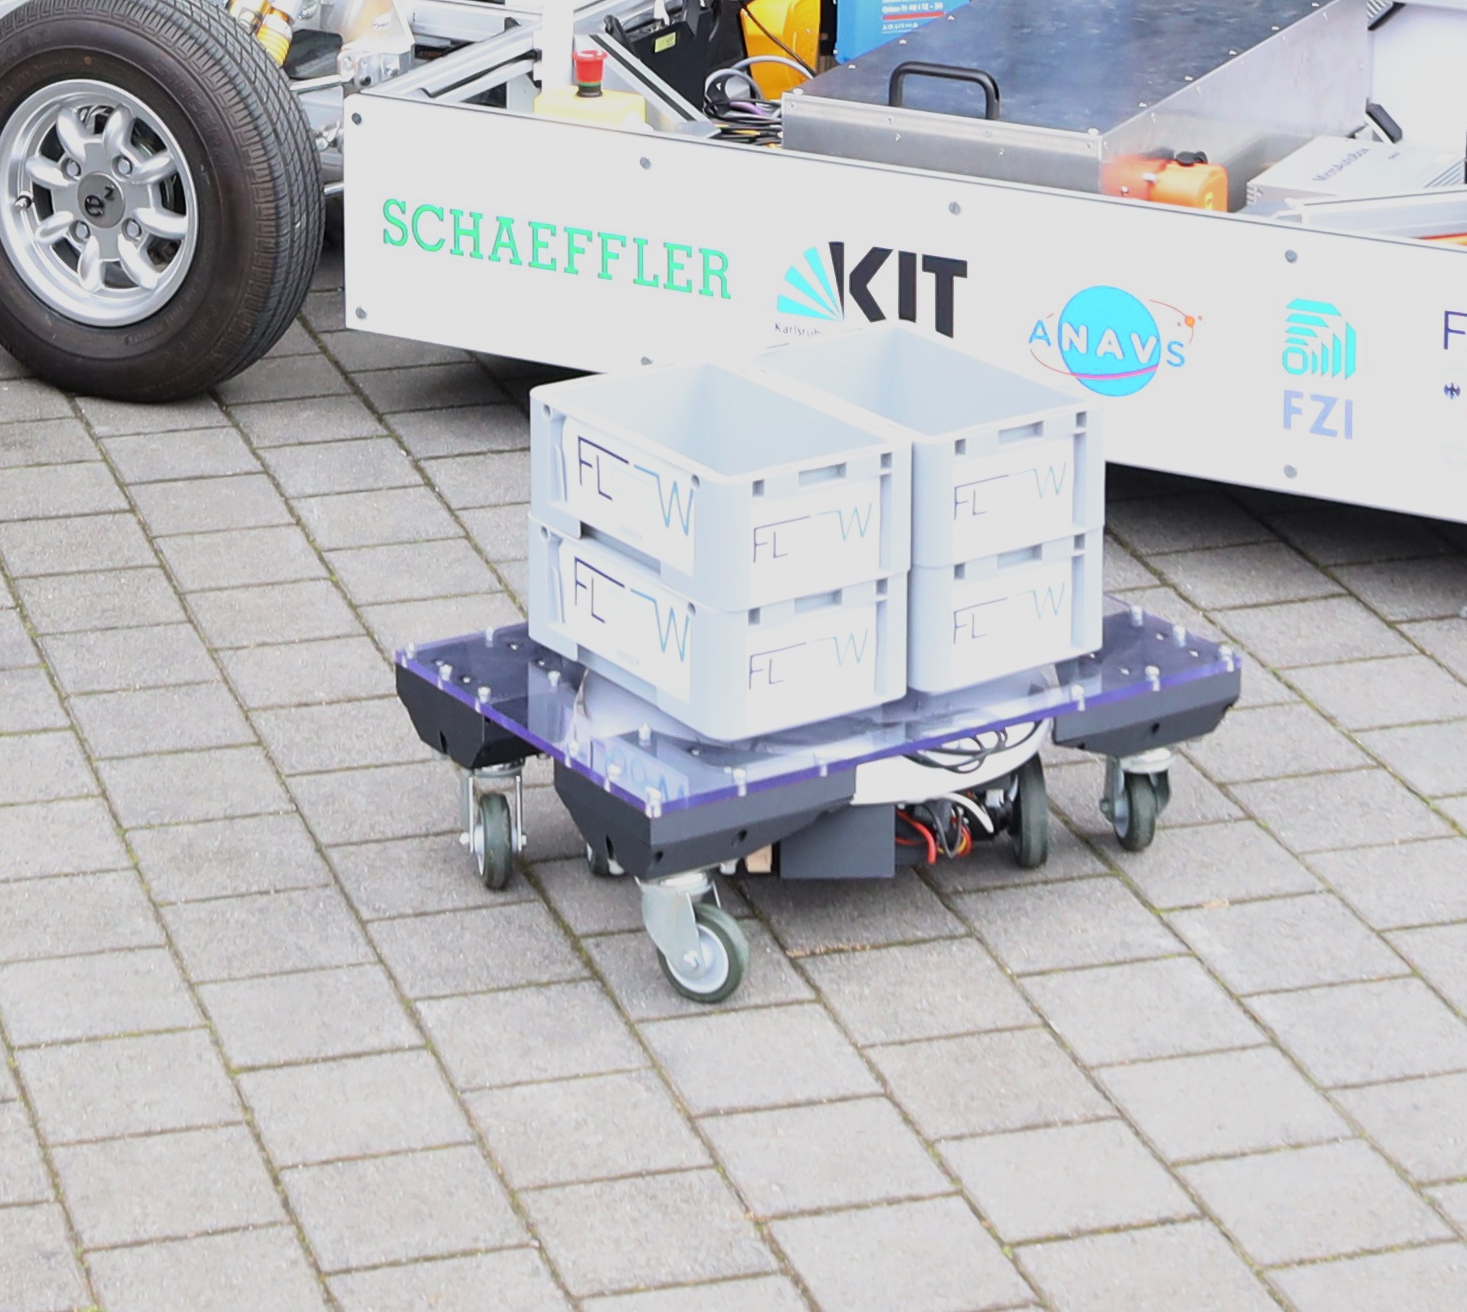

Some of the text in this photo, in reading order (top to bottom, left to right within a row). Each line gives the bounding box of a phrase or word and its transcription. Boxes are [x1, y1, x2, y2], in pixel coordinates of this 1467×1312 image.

[383, 198, 731, 300] SCHAEFFLER
[829, 242, 967, 338] KIT
[1028, 319, 1186, 367] ANAVS
[1283, 390, 1354, 440] FZI
